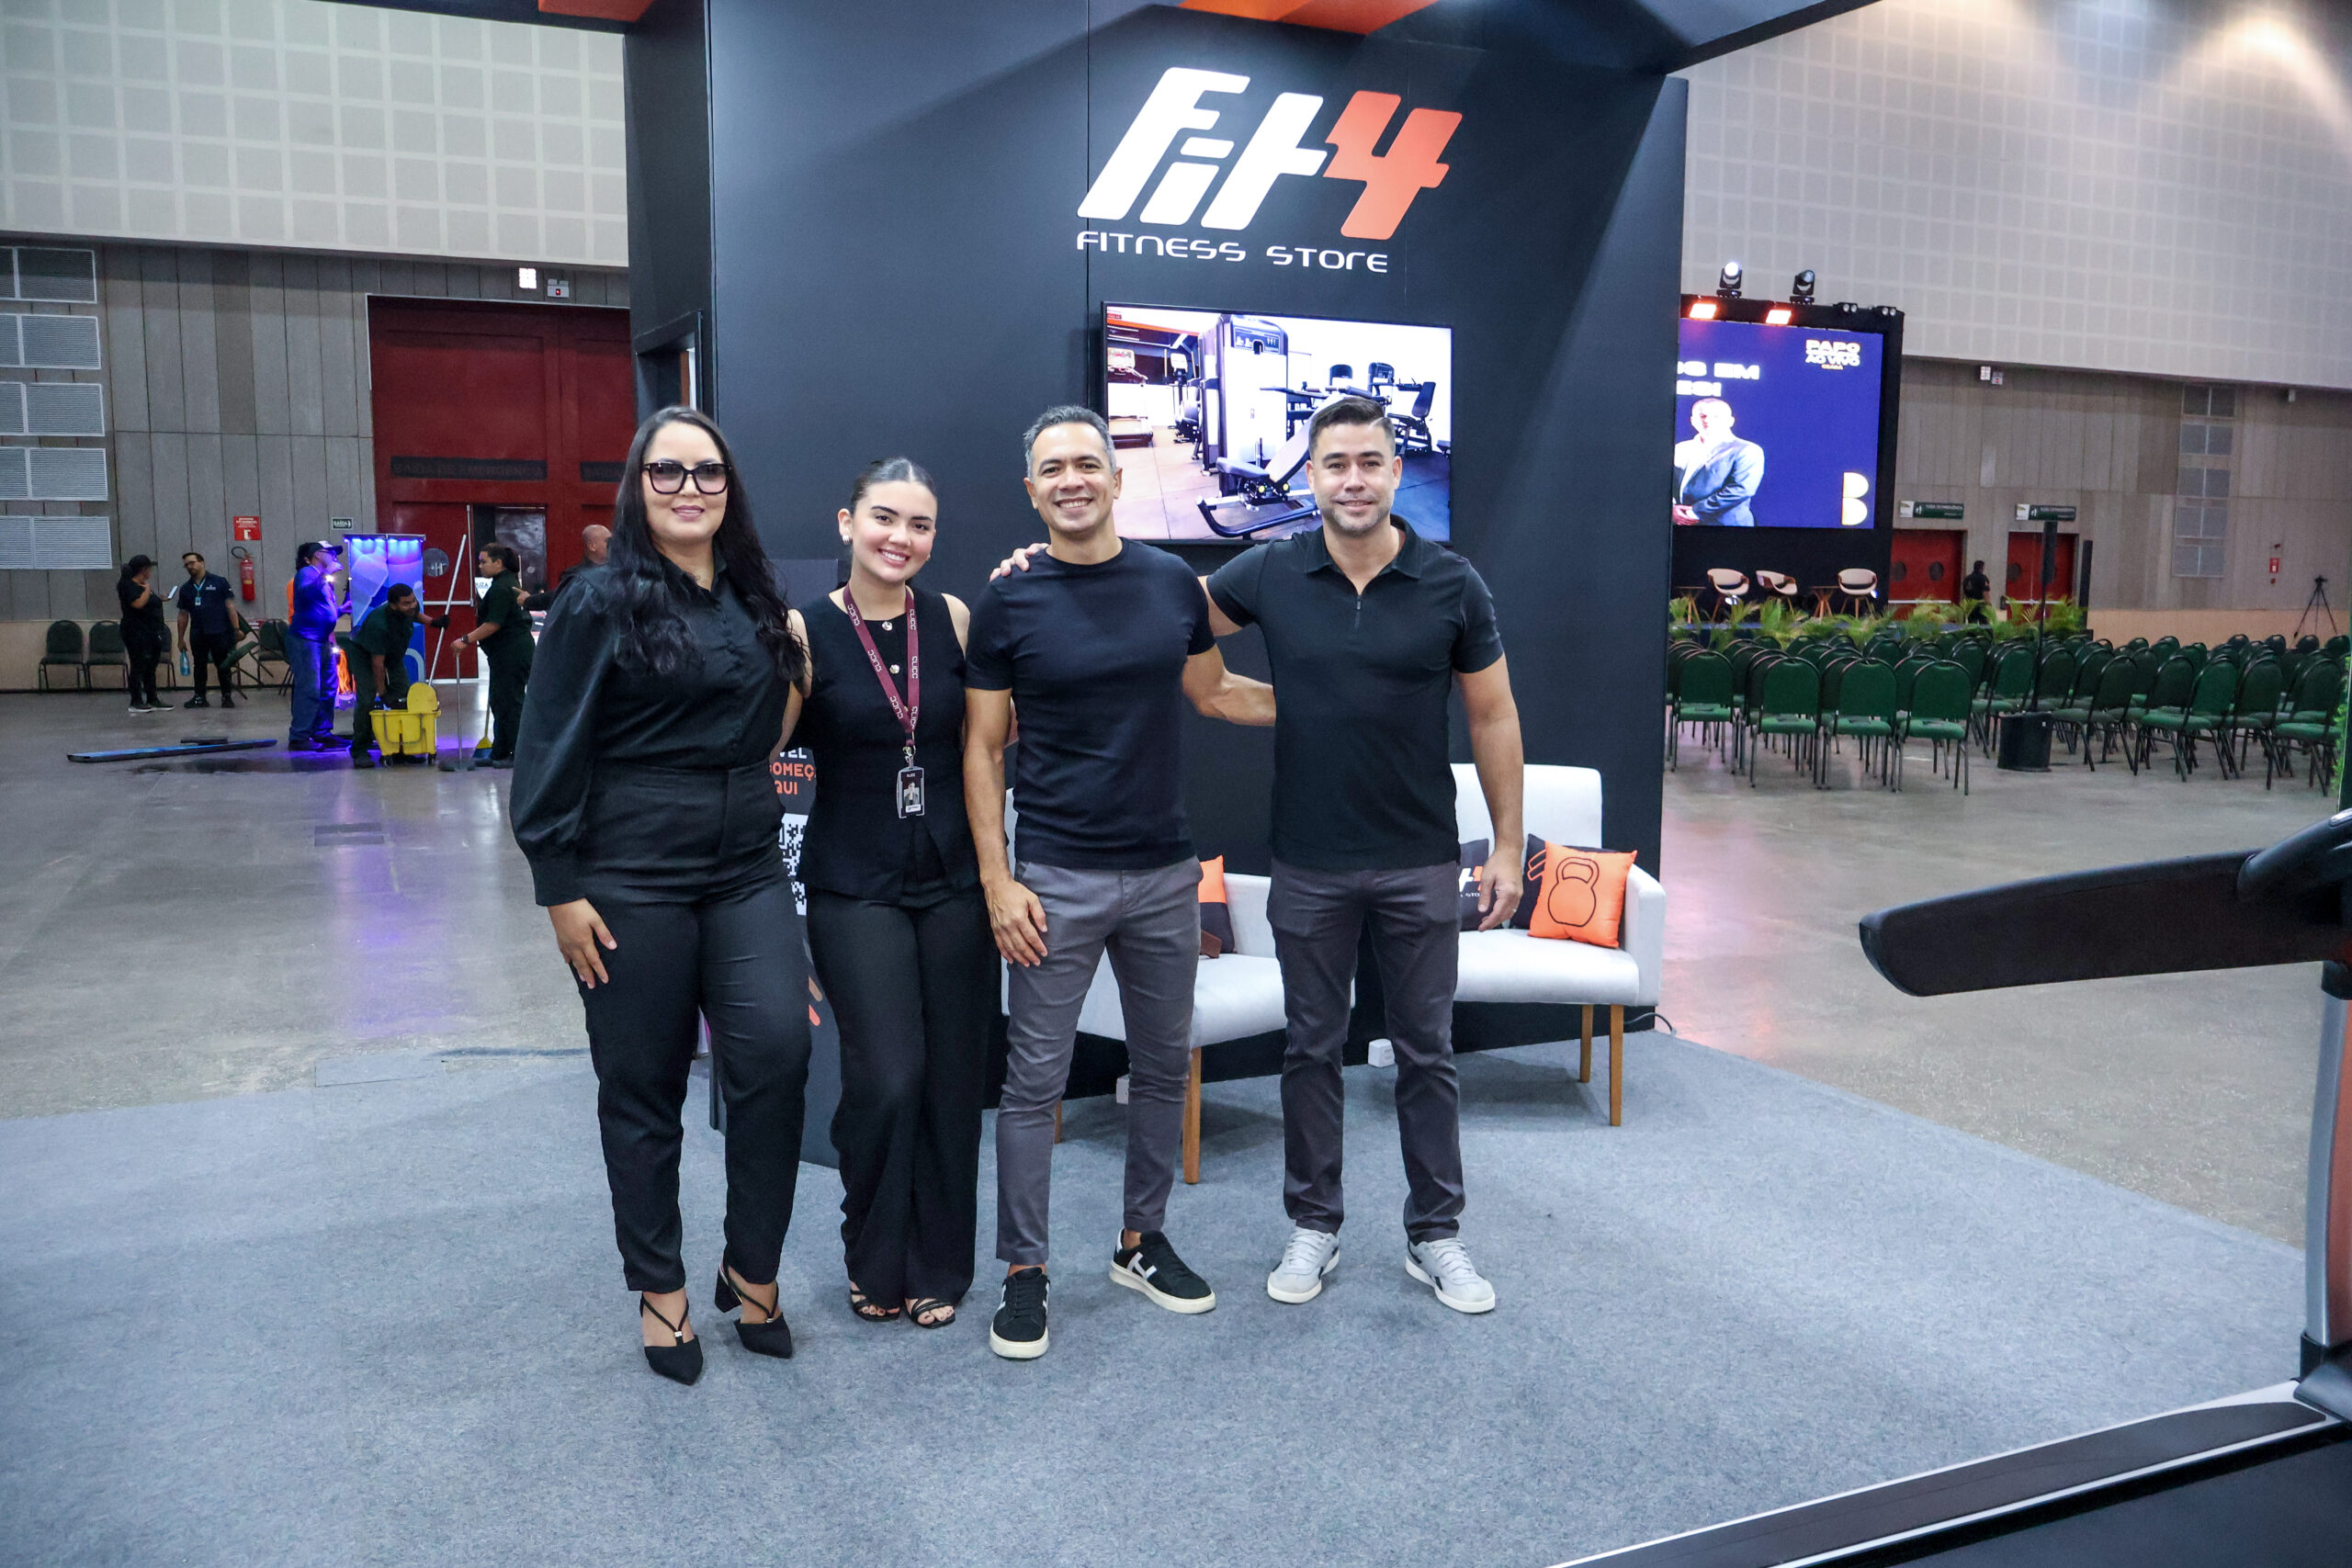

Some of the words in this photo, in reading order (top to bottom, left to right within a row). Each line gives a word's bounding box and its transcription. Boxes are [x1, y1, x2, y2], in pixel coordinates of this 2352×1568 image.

[1077, 231, 1247, 262] FITNESS
[1266, 245, 1388, 273] STORE
[1805, 339, 1860, 353] PAPO
[1713, 362, 1759, 379] EM
[1841, 471, 1869, 525] B
[770, 761, 816, 781] OMEÇ
[775, 780, 797, 795] QUI
